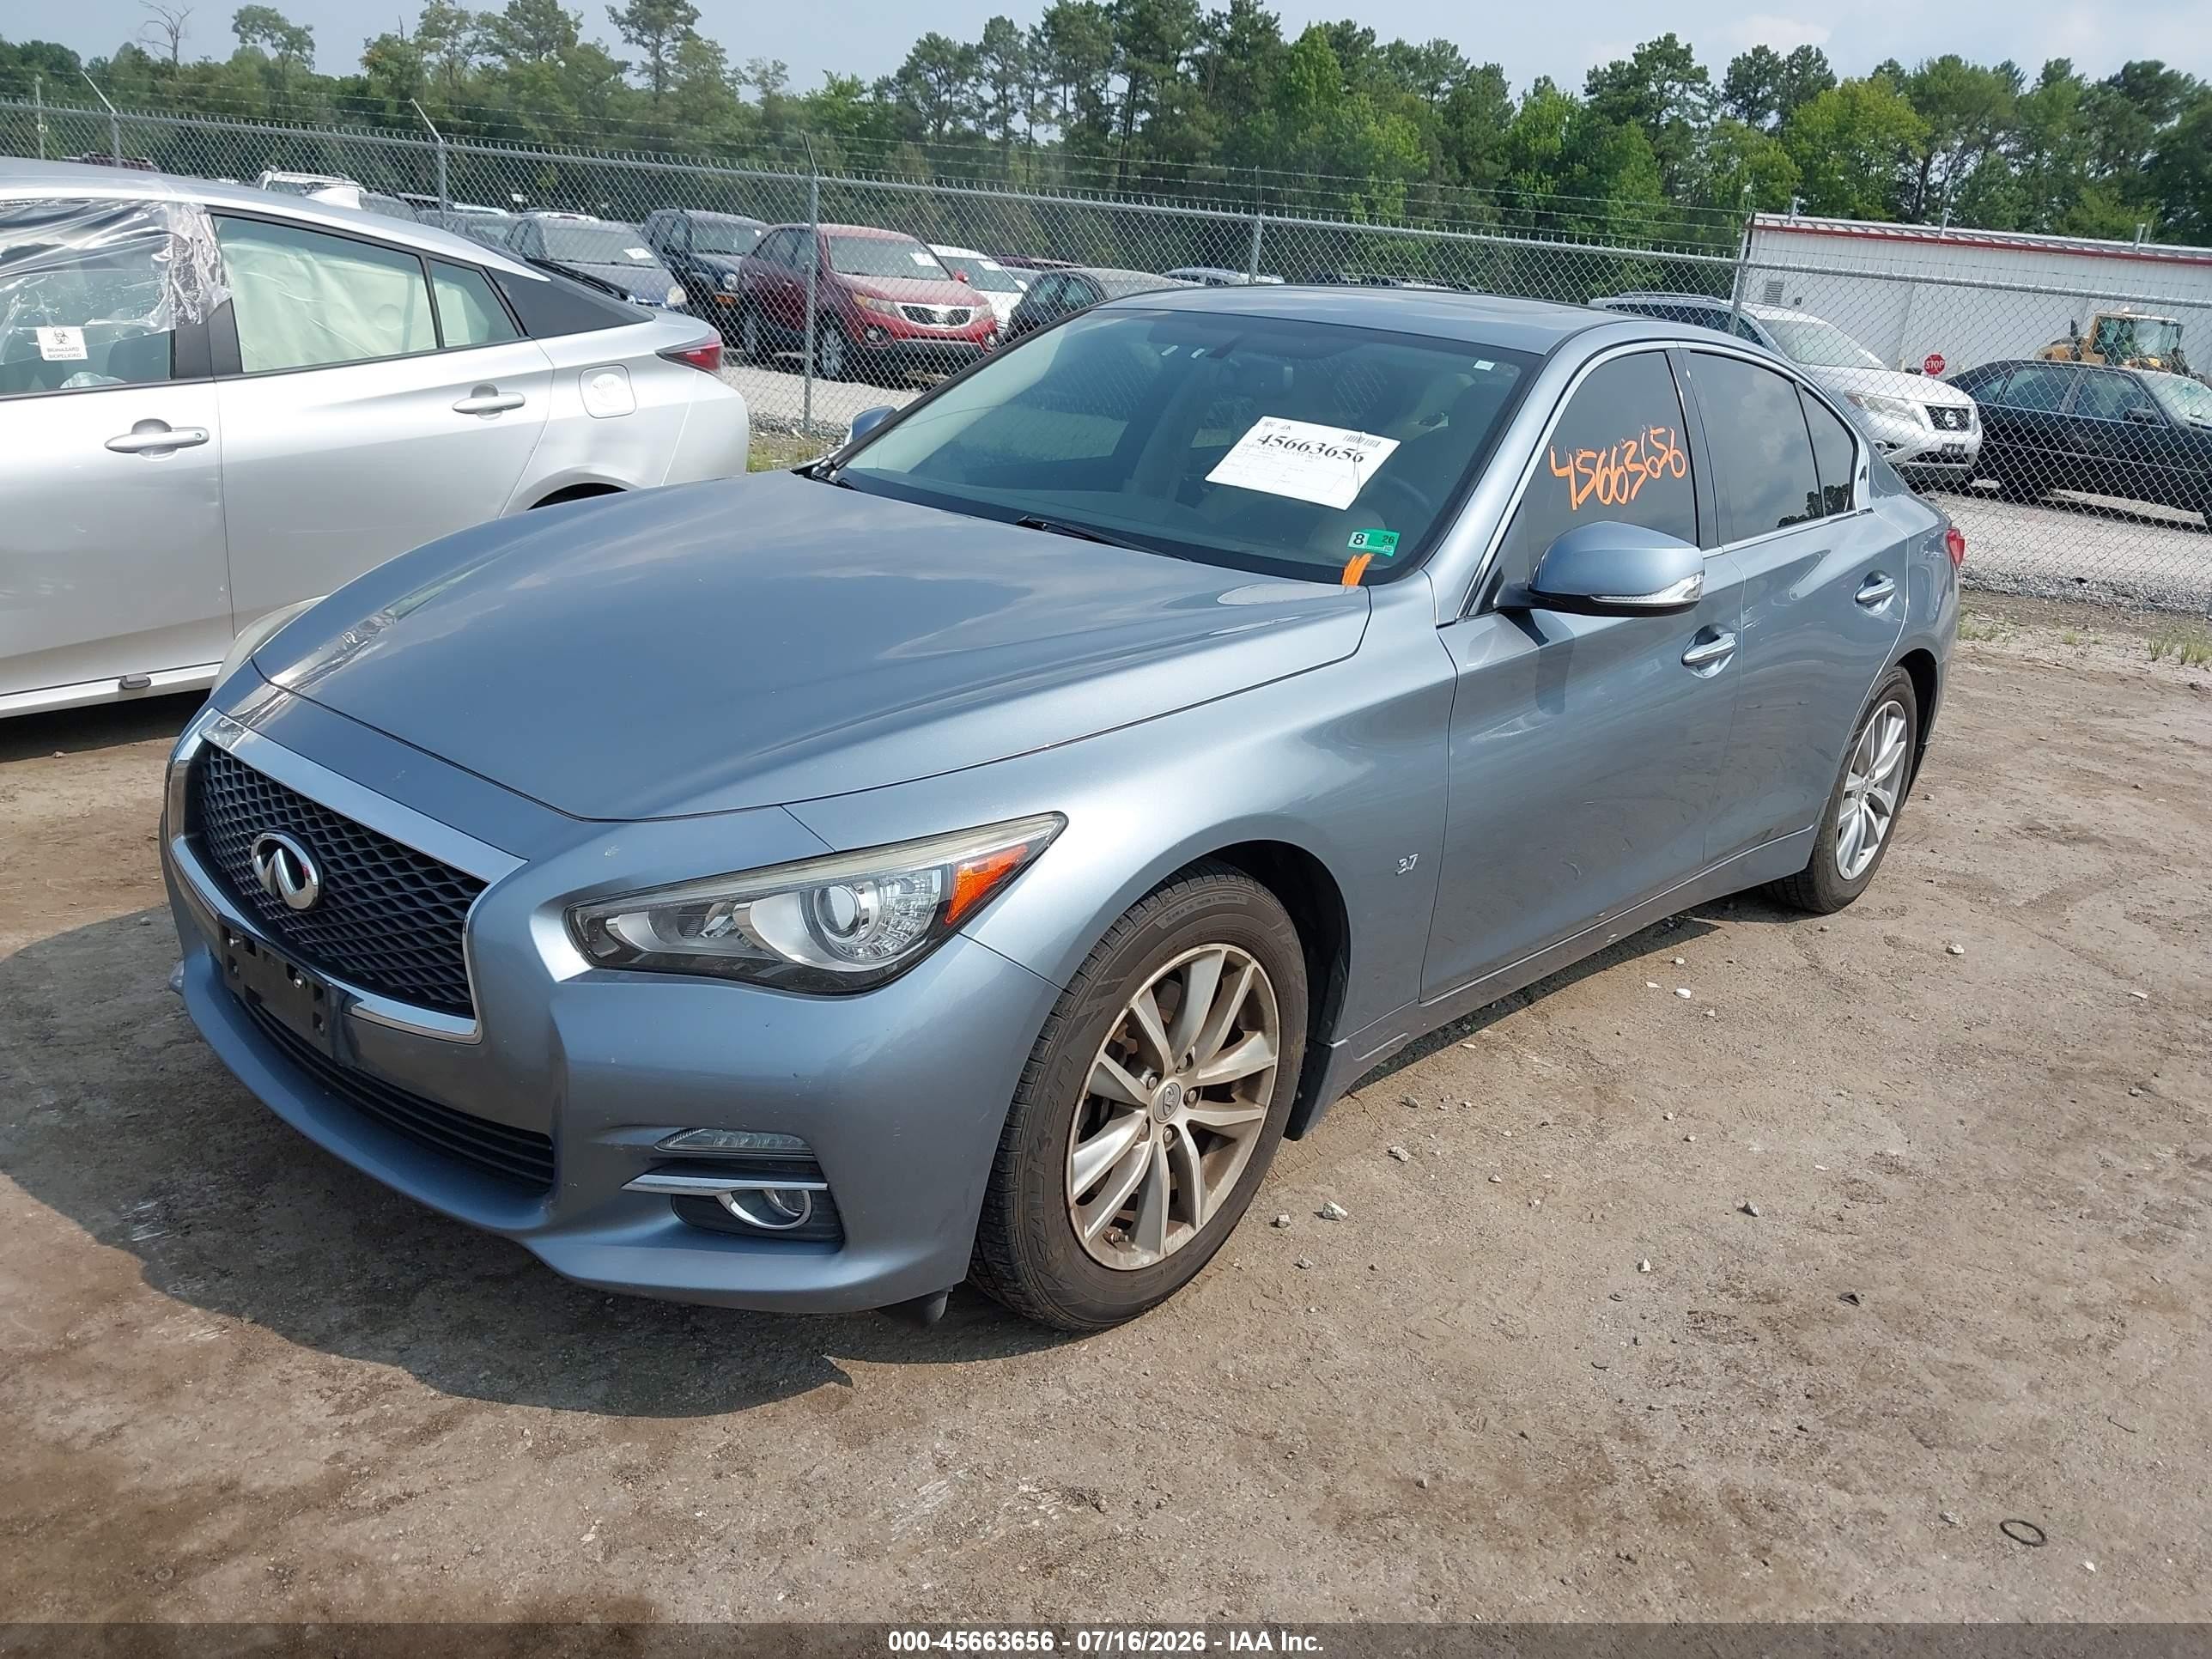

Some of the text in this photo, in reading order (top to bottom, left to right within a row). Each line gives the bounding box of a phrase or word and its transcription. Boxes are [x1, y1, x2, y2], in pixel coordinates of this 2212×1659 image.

[1925, 361, 1944, 370] STOP
[1257, 434, 1368, 463] 45663656
[1550, 424, 1686, 511] 45663656
[1353, 533, 1365, 545] 8
[1382, 535, 1395, 544] 26
